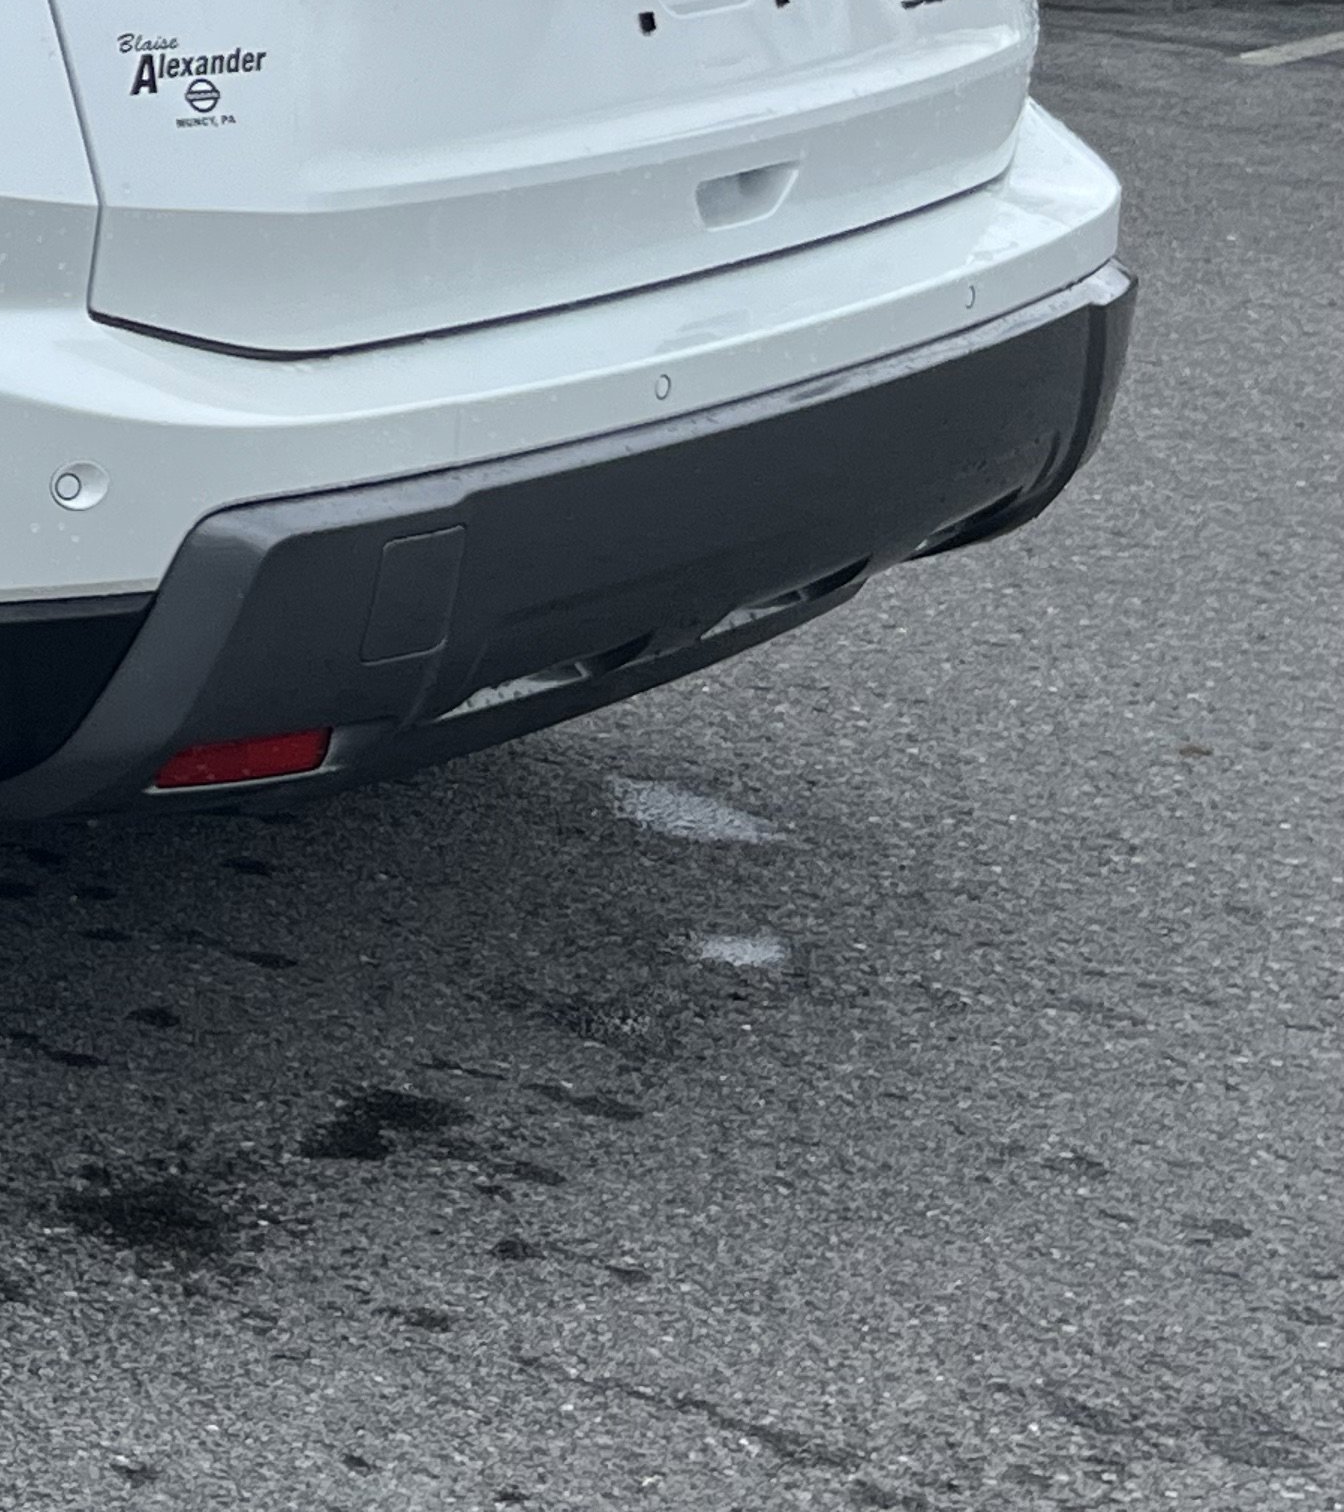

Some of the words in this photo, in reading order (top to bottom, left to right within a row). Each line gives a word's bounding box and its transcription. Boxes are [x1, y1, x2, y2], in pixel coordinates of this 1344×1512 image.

[117, 33, 179, 53] Blaise
[130, 47, 267, 96] Alexander
[221, 115, 236, 125] PA
